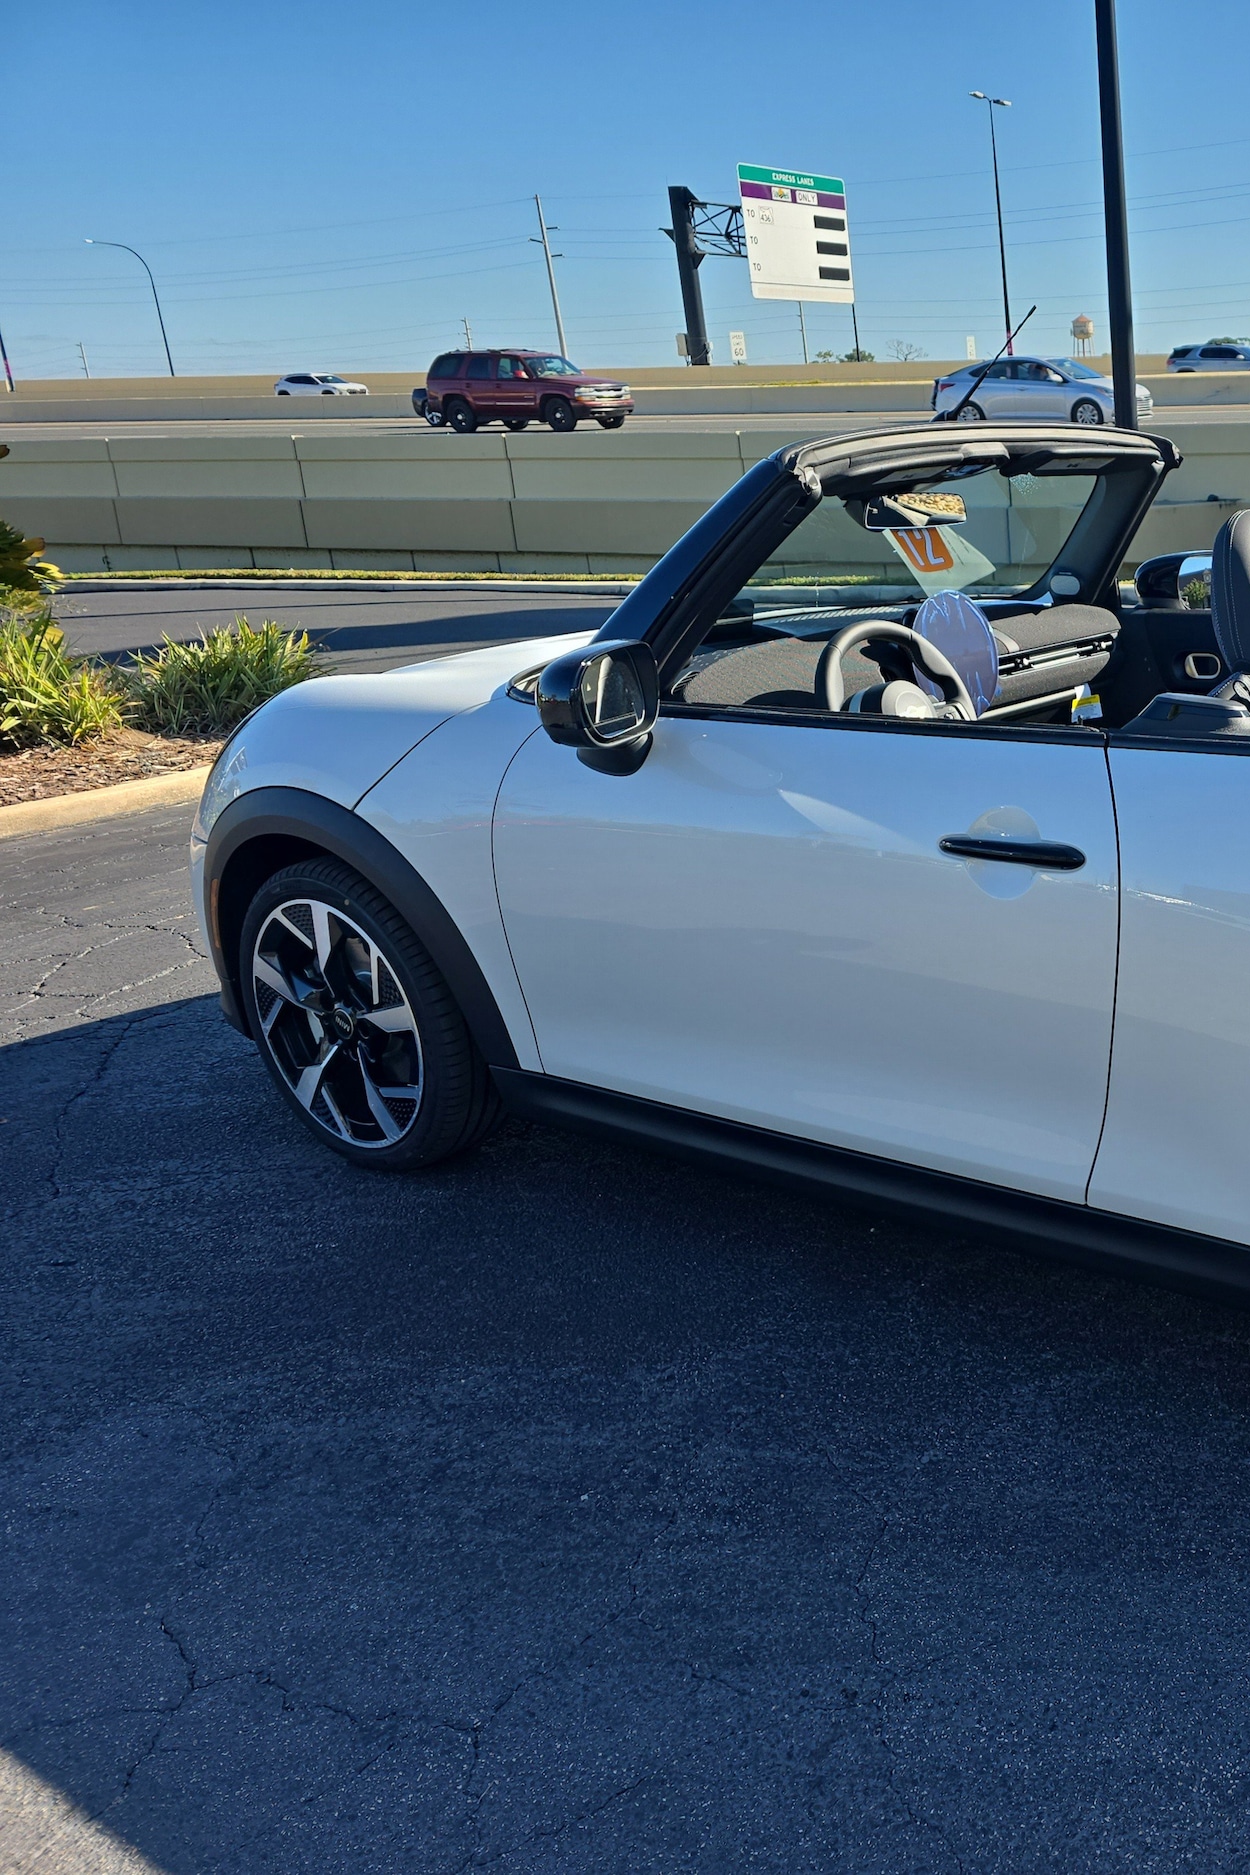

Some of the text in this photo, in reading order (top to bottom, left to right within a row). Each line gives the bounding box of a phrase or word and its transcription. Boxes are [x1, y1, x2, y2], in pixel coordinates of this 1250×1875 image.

[772, 172, 814, 186] EXPRESS LANES
[798, 192, 815, 202] ONLY
[747, 209, 755, 218] TO
[760, 213, 771, 222] 436
[750, 236, 758, 245] TO
[753, 262, 761, 271] TO
[734, 347, 744, 356] 60
[897, 527, 945, 566] 12
[335, 1015, 350, 1032] MINI
